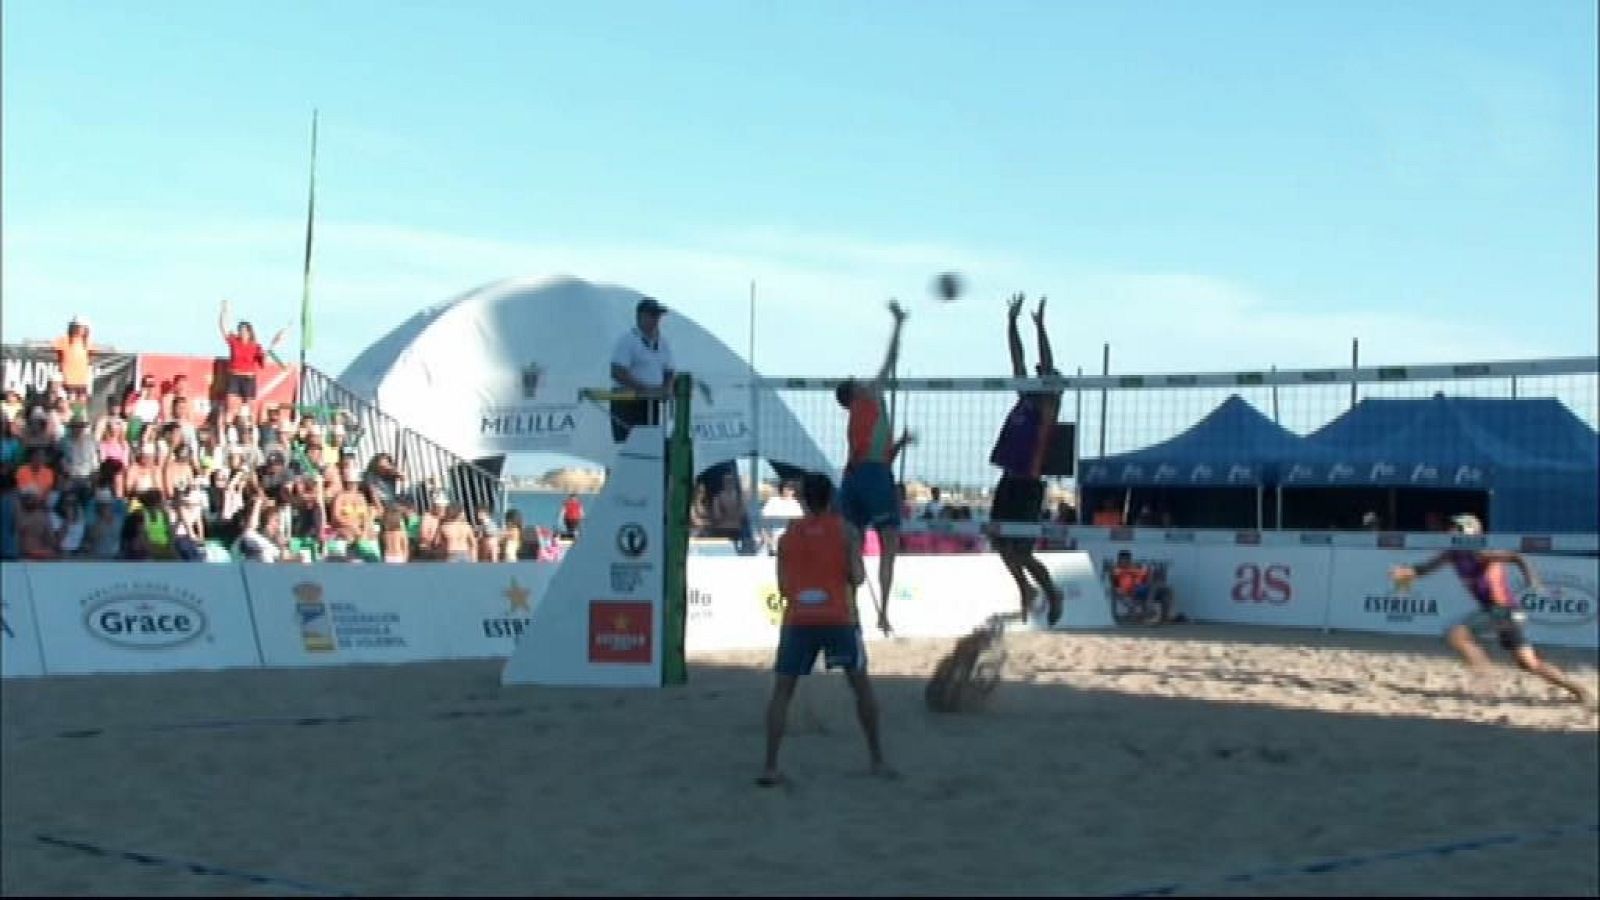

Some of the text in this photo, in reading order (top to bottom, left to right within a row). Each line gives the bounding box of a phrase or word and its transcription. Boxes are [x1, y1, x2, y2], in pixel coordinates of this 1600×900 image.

[481, 412, 576, 434] MELILLA
[1231, 562, 1291, 605] as
[1364, 596, 1439, 615] ESTRELLA
[1521, 593, 1590, 614] Grace
[100, 611, 192, 634] Grace
